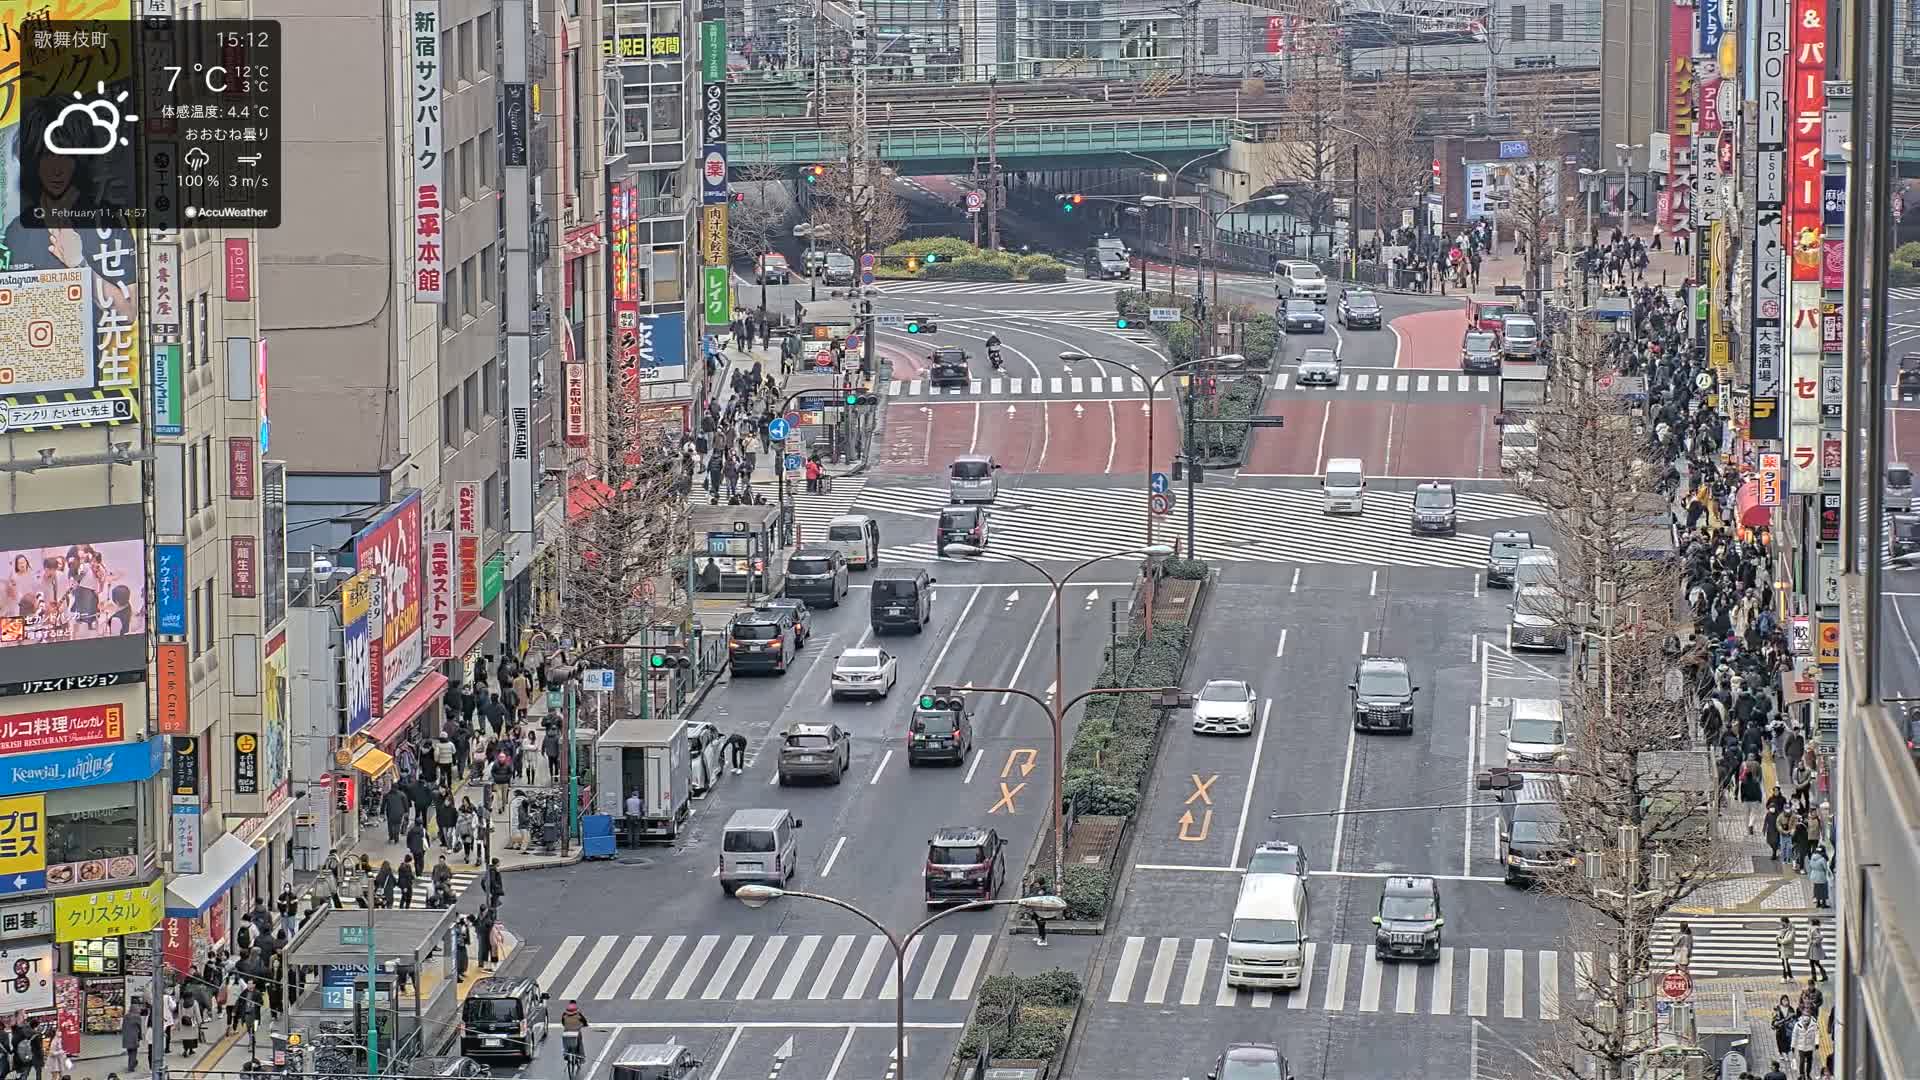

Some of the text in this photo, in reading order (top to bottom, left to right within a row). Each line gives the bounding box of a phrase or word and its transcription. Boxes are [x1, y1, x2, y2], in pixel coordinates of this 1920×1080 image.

[618, 38, 645, 56] 祝日
[651, 36, 680, 55] 夜間
[1704, 87, 1716, 120] アコム
[415, 11, 441, 292] 新宿サンパーク 三平本館
[707, 161, 724, 177] 薬
[710, 208, 723, 263] 肉汁水餃子
[709, 274, 722, 314] レイク
[1758, 329, 1772, 382] 大衆酒場
[156, 354, 167, 414] FamilyMart
[1793, 308, 1818, 469] パセラ
[53, 405, 110, 420] たいせい先生
[513, 407, 527, 460] HOMEGAME
[459, 486, 471, 533] GAME
[1827, 497, 1839, 506] 3F
[431, 542, 448, 629] 三平ストア
[0, 715, 68, 739] ルコ料理
[24, 735, 67, 747] RESTAURANT
[3, 911, 38, 931] 囲碁
[68, 904, 141, 927] クリスタル
[327, 991, 341, 1004] 12
